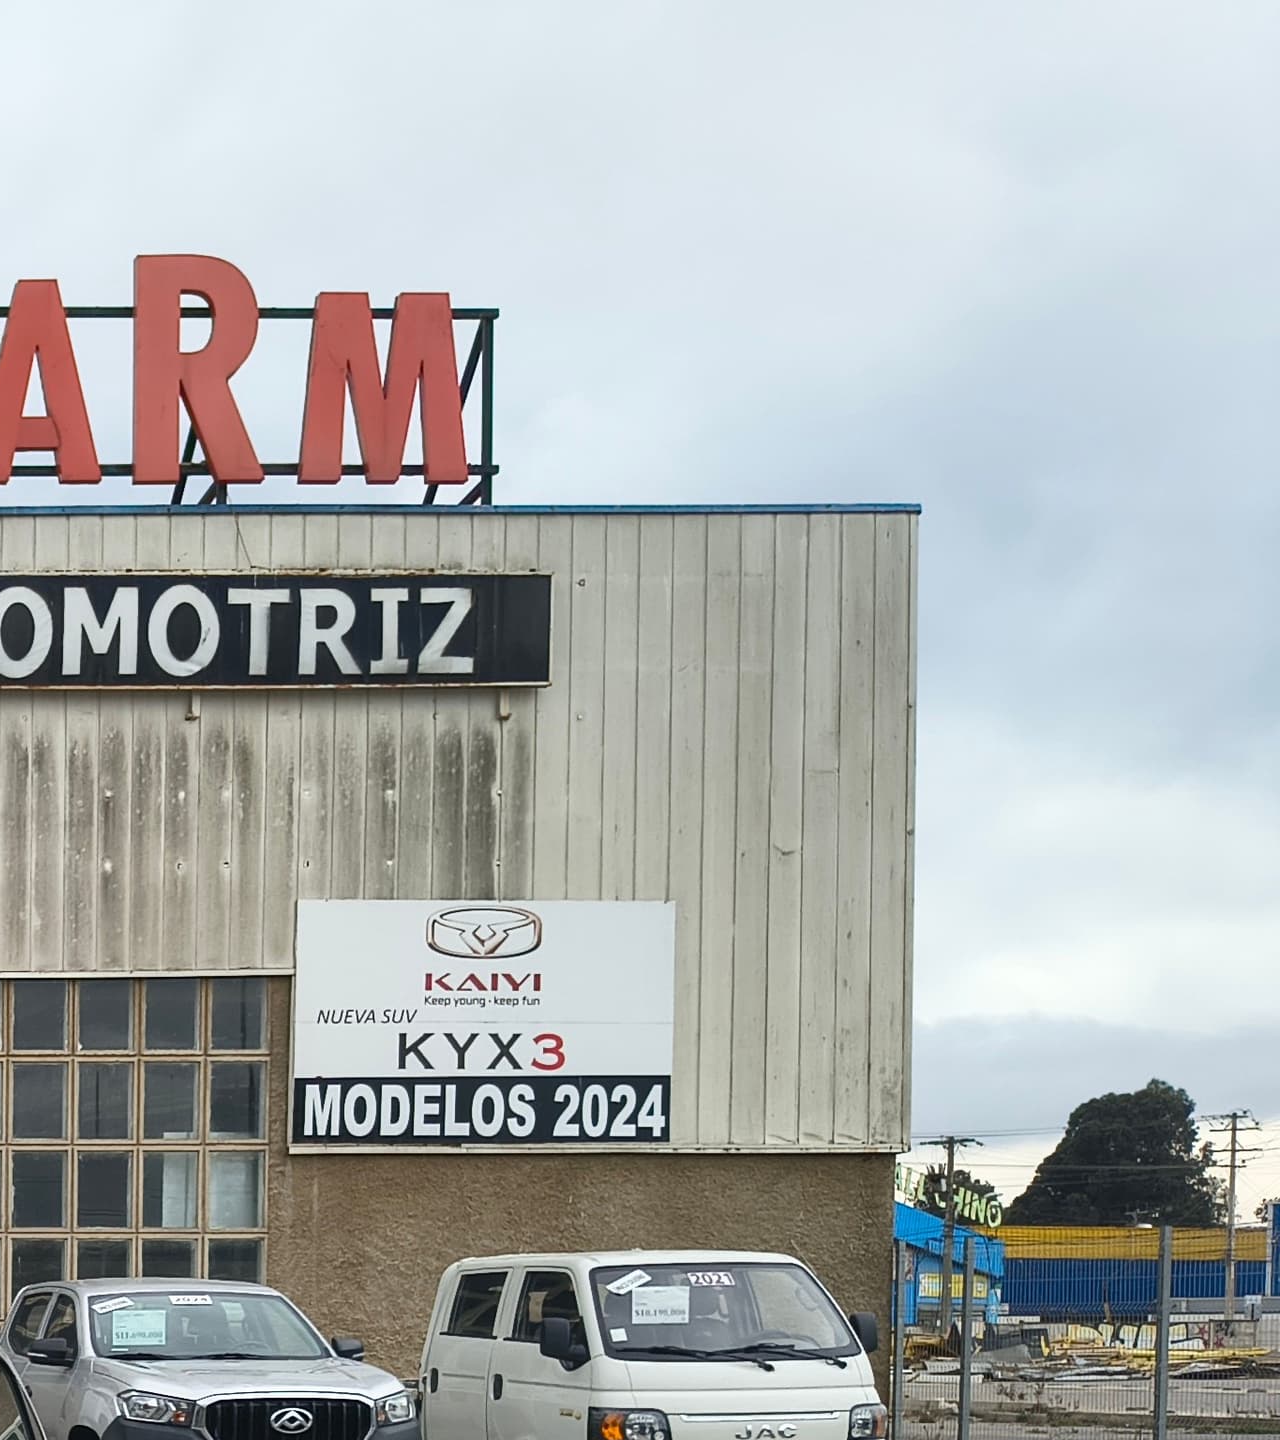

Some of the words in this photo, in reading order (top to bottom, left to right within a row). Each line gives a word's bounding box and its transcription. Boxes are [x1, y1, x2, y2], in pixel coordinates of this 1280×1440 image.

[424, 973, 542, 992] KAIYI
[424, 995, 451, 1007] Keep
[453, 996, 486, 1008] young
[493, 995, 520, 1008] keep
[522, 995, 541, 1007] fun
[316, 1009, 377, 1025] NUEVA
[380, 1009, 418, 1024] SUV
[397, 1033, 566, 1071] KYX3
[303, 1083, 537, 1138] MODELOS
[552, 1083, 666, 1138] 2024
[691, 1273, 735, 1286] 2021
[735, 1423, 798, 1440] JAC
